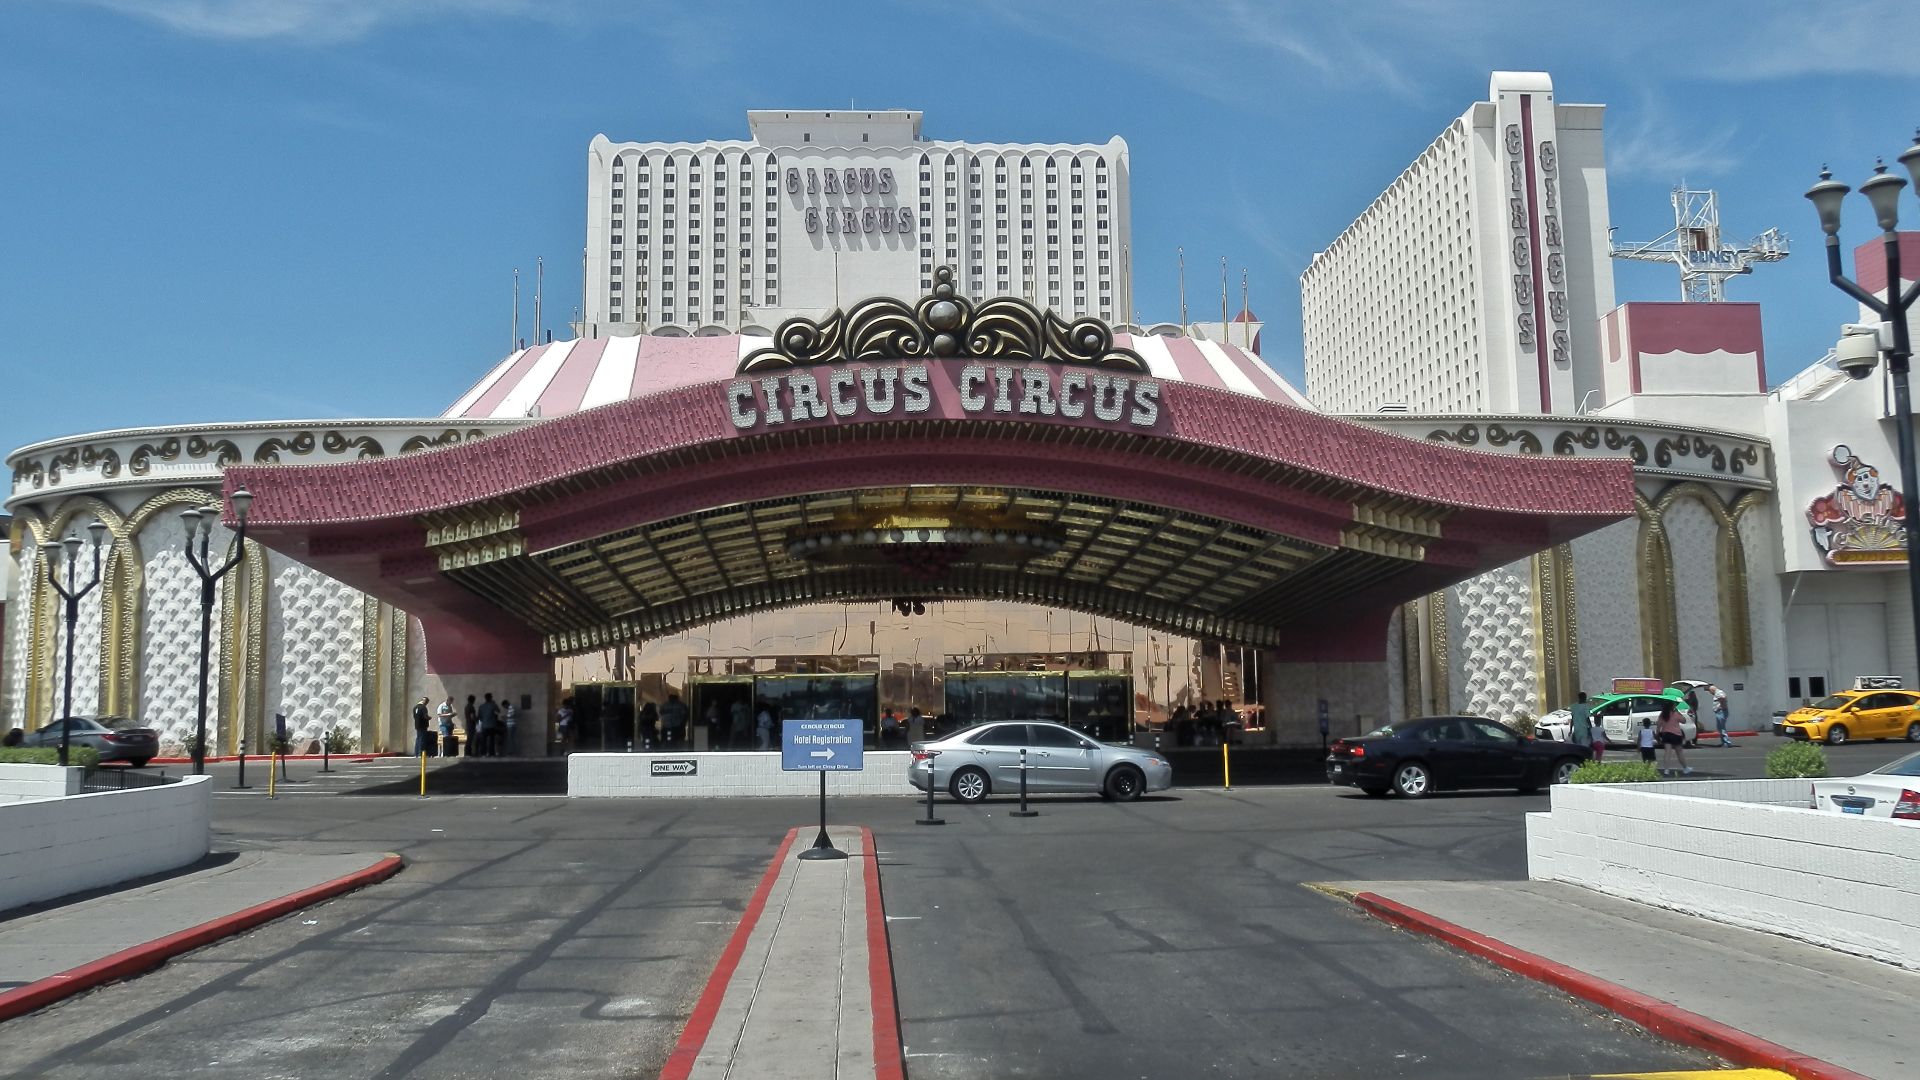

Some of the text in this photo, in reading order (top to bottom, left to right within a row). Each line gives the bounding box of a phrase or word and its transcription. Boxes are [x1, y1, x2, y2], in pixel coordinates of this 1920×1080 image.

[786, 168, 893, 194] CIRCUS
[805, 207, 913, 233] CIRCUS
[1505, 124, 1534, 344] CIRCUS
[1539, 141, 1570, 361] CIRCUS
[727, 365, 1159, 428] CIRCUS CIRCUS
[794, 735, 852, 745] Hotel Registration
